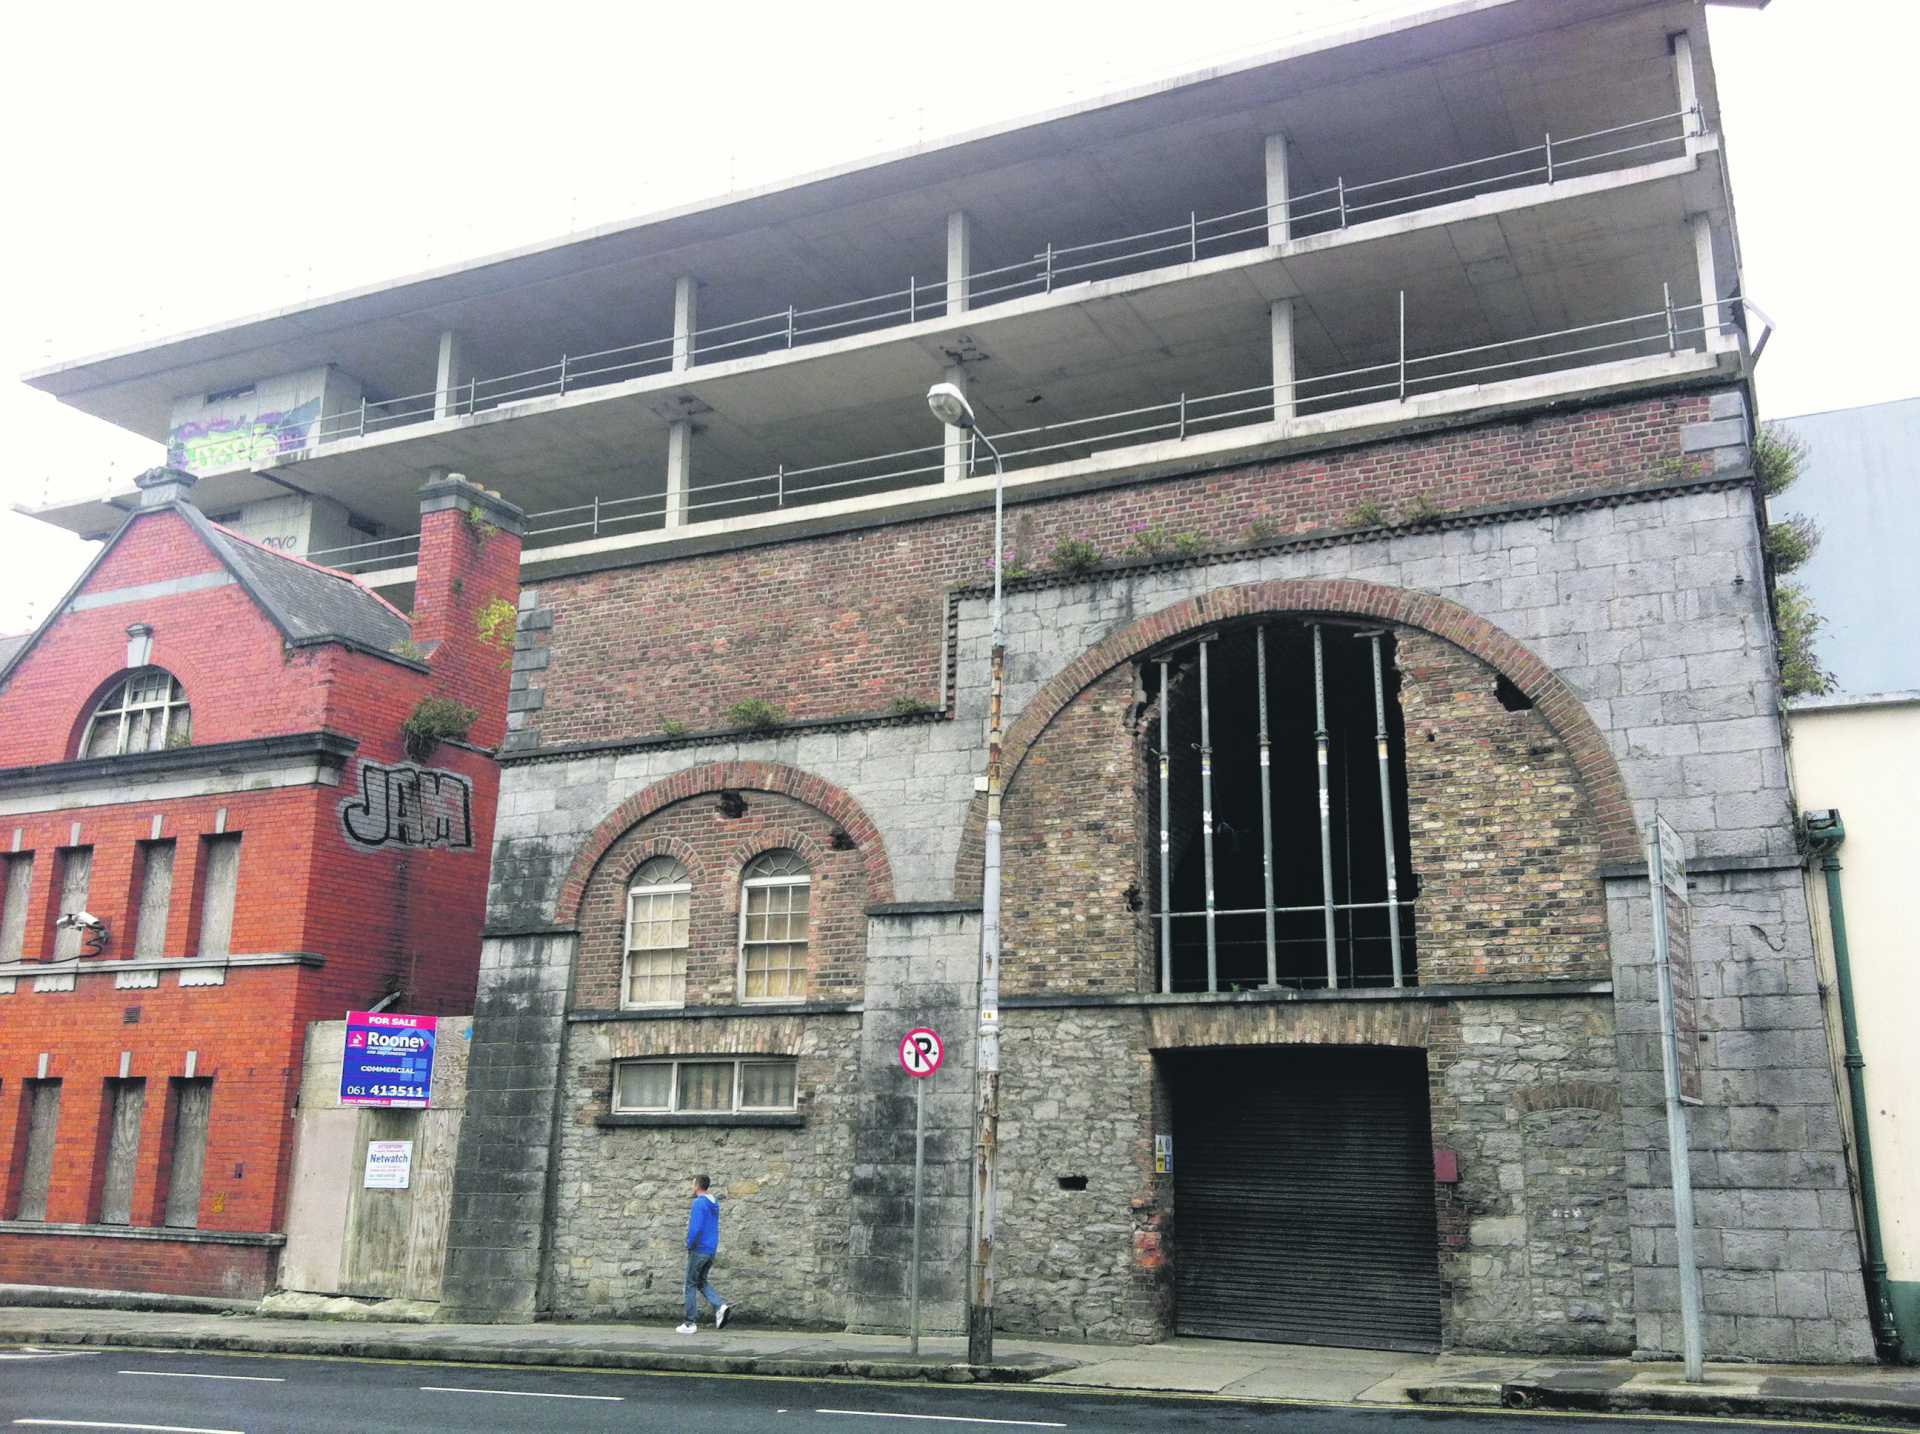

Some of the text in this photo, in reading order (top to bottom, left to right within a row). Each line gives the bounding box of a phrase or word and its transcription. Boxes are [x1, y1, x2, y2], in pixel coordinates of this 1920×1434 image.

[368, 1016, 417, 1027] FOR SALE
[367, 1031, 426, 1049] Rooney
[360, 1065, 416, 1074] COMMERCIAL
[347, 1084, 424, 1098] 061 413511
[370, 1153, 408, 1163] Netwatch
